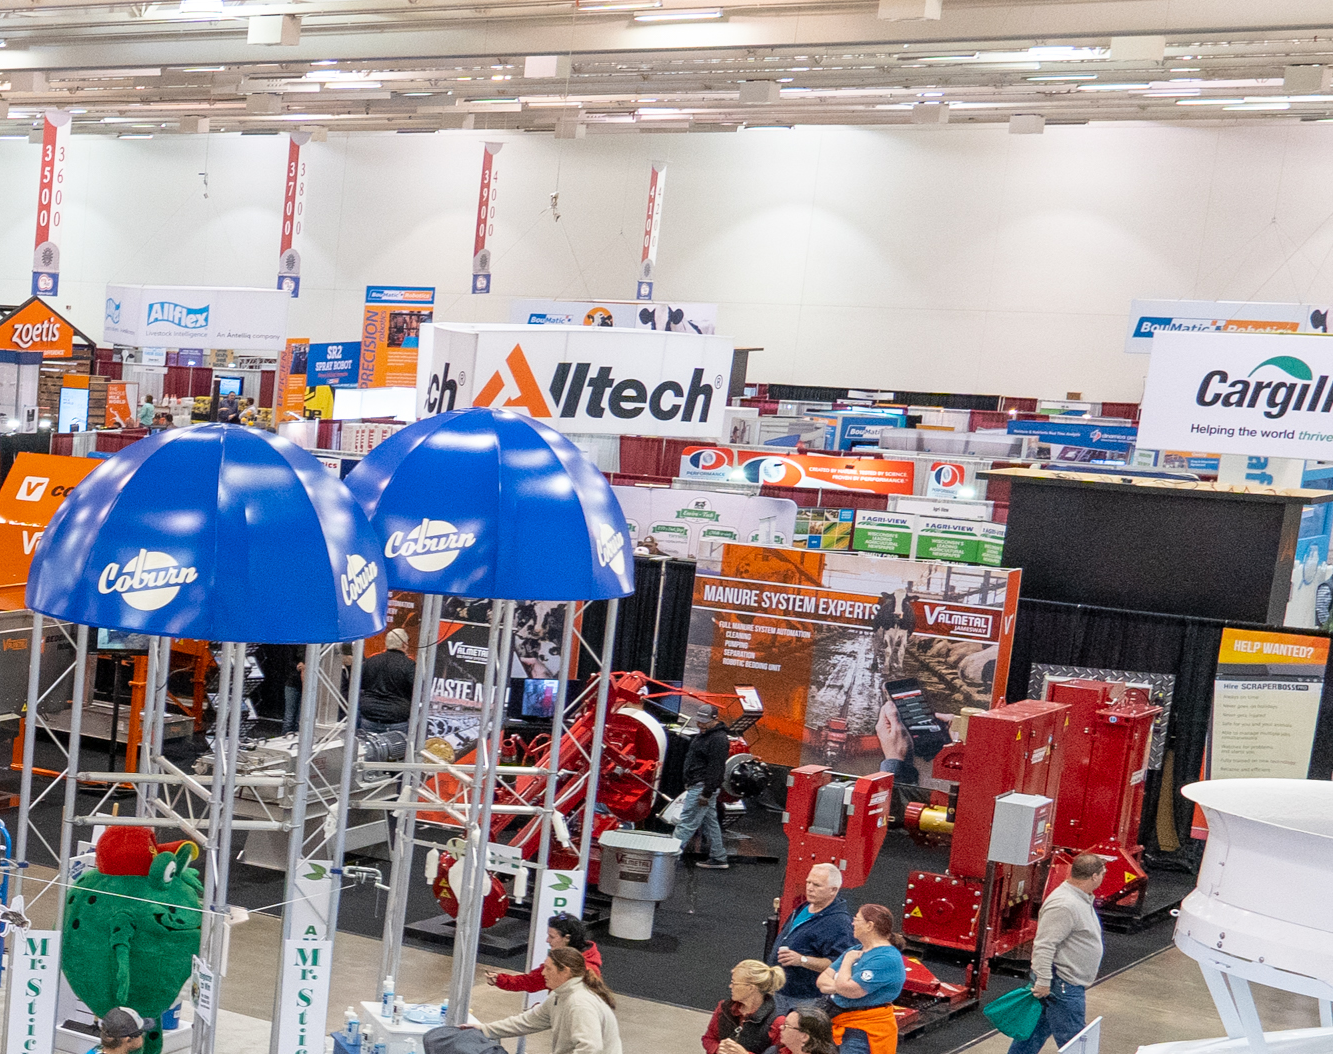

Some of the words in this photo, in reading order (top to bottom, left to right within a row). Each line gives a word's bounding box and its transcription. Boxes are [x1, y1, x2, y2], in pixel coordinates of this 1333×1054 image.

[39, 145, 52, 227] 3500
[53, 146, 65, 227] 3600
[284, 162, 295, 235] 3700
[296, 162, 306, 235] 3800
[479, 170, 489, 237] 3900
[488, 170, 498, 236] 4000
[645, 185, 655, 248] 4100
[148, 302, 209, 328] Allflex
[11, 316, 61, 349] zoetis
[252, 333, 280, 341] company
[359, 310, 379, 388] PRECISION
[315, 362, 333, 371] SPRAY
[333, 360, 352, 370] ROBOT
[327, 345, 343, 359] SR2
[472, 343, 714, 424] Alltech
[1191, 423, 1235, 438] Helping
[1238, 425, 1257, 437] the
[1260, 426, 1295, 440] world
[686, 470, 726, 478] PERFORMANCE
[865, 515, 908, 525] AGRI-VIEW
[930, 522, 975, 532] AGRI-VIEW
[385, 518, 476, 559] Coburn
[596, 523, 625, 568] Coburn
[98, 548, 198, 594] Coburn
[341, 554, 379, 606] Coburn
[703, 584, 759, 608] MANURE
[761, 591, 816, 614] SYSTEM
[818, 598, 881, 621] EXPERTS
[923, 605, 988, 629] VALMETAL
[718, 620, 732, 629] FULL
[732, 622, 755, 632] MANURE
[754, 625, 776, 635] SYSTEM
[776, 627, 811, 639] AUTOMATION
[724, 640, 749, 649] PUMPING
[725, 630, 752, 641] CLEANING
[954, 624, 987, 634] JAMESWAY
[722, 657, 745, 668] ROBOTIC
[723, 648, 756, 660] SEPARATION
[1233, 639, 1261, 654] HELP
[1263, 642, 1314, 659] WANTED?
[23, 936, 51, 972] Mr.
[294, 947, 322, 981] Mr.
